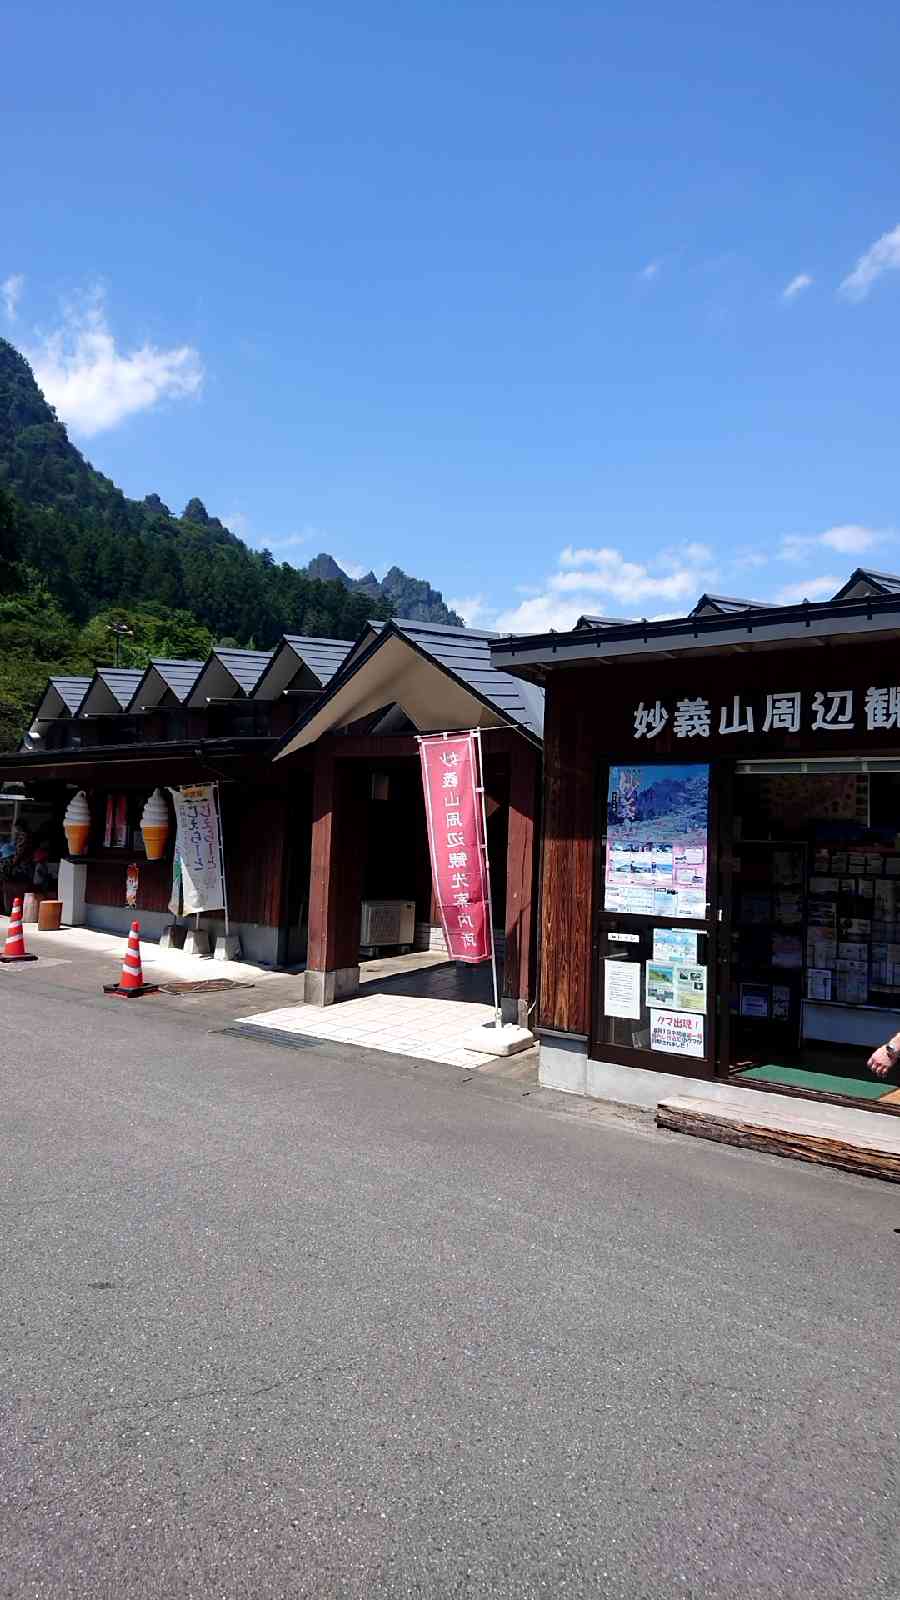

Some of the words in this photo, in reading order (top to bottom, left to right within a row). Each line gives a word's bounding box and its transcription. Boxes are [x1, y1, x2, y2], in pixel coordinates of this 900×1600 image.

[633, 686, 900, 739] 妙義山周辺観
